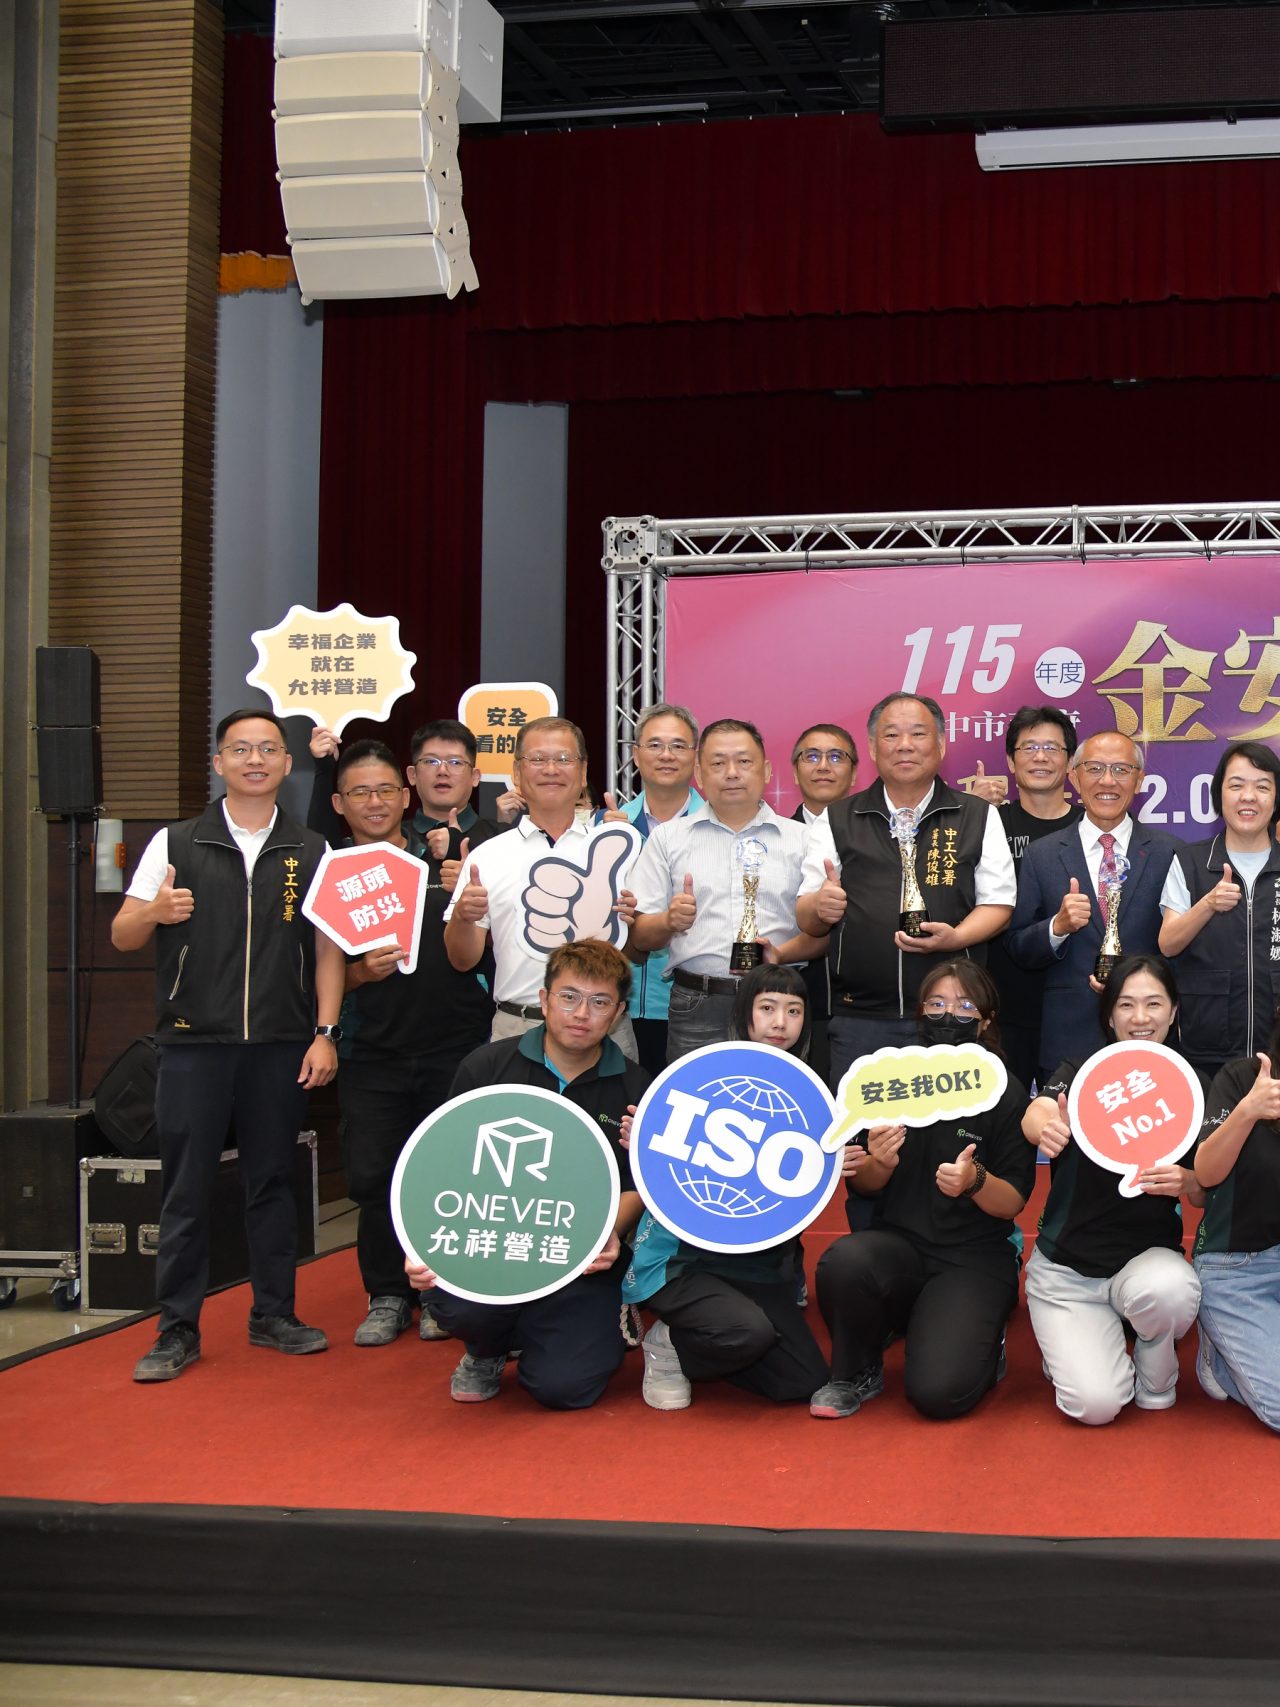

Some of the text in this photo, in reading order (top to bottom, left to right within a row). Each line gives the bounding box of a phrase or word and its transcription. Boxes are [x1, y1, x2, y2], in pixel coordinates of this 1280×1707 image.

[288, 633, 377, 650] 幸福企業
[901, 624, 1083, 694] 115 年度
[310, 655, 355, 673] 就在
[288, 678, 377, 696] 允祥營造
[486, 707, 528, 727] 安全
[1138, 774, 1220, 824] 2.0
[941, 827, 958, 886] 中工分署
[283, 857, 299, 922] 中工分署
[335, 863, 393, 902] 源頭
[348, 892, 406, 933] 防災
[861, 1068, 982, 1106] 安全我OK!
[1095, 1069, 1157, 1114] 安全
[1111, 1098, 1176, 1146] No.1
[648, 1088, 826, 1198] ISO
[434, 1190, 576, 1229] ONEVER
[427, 1225, 571, 1265] 允祥營造
